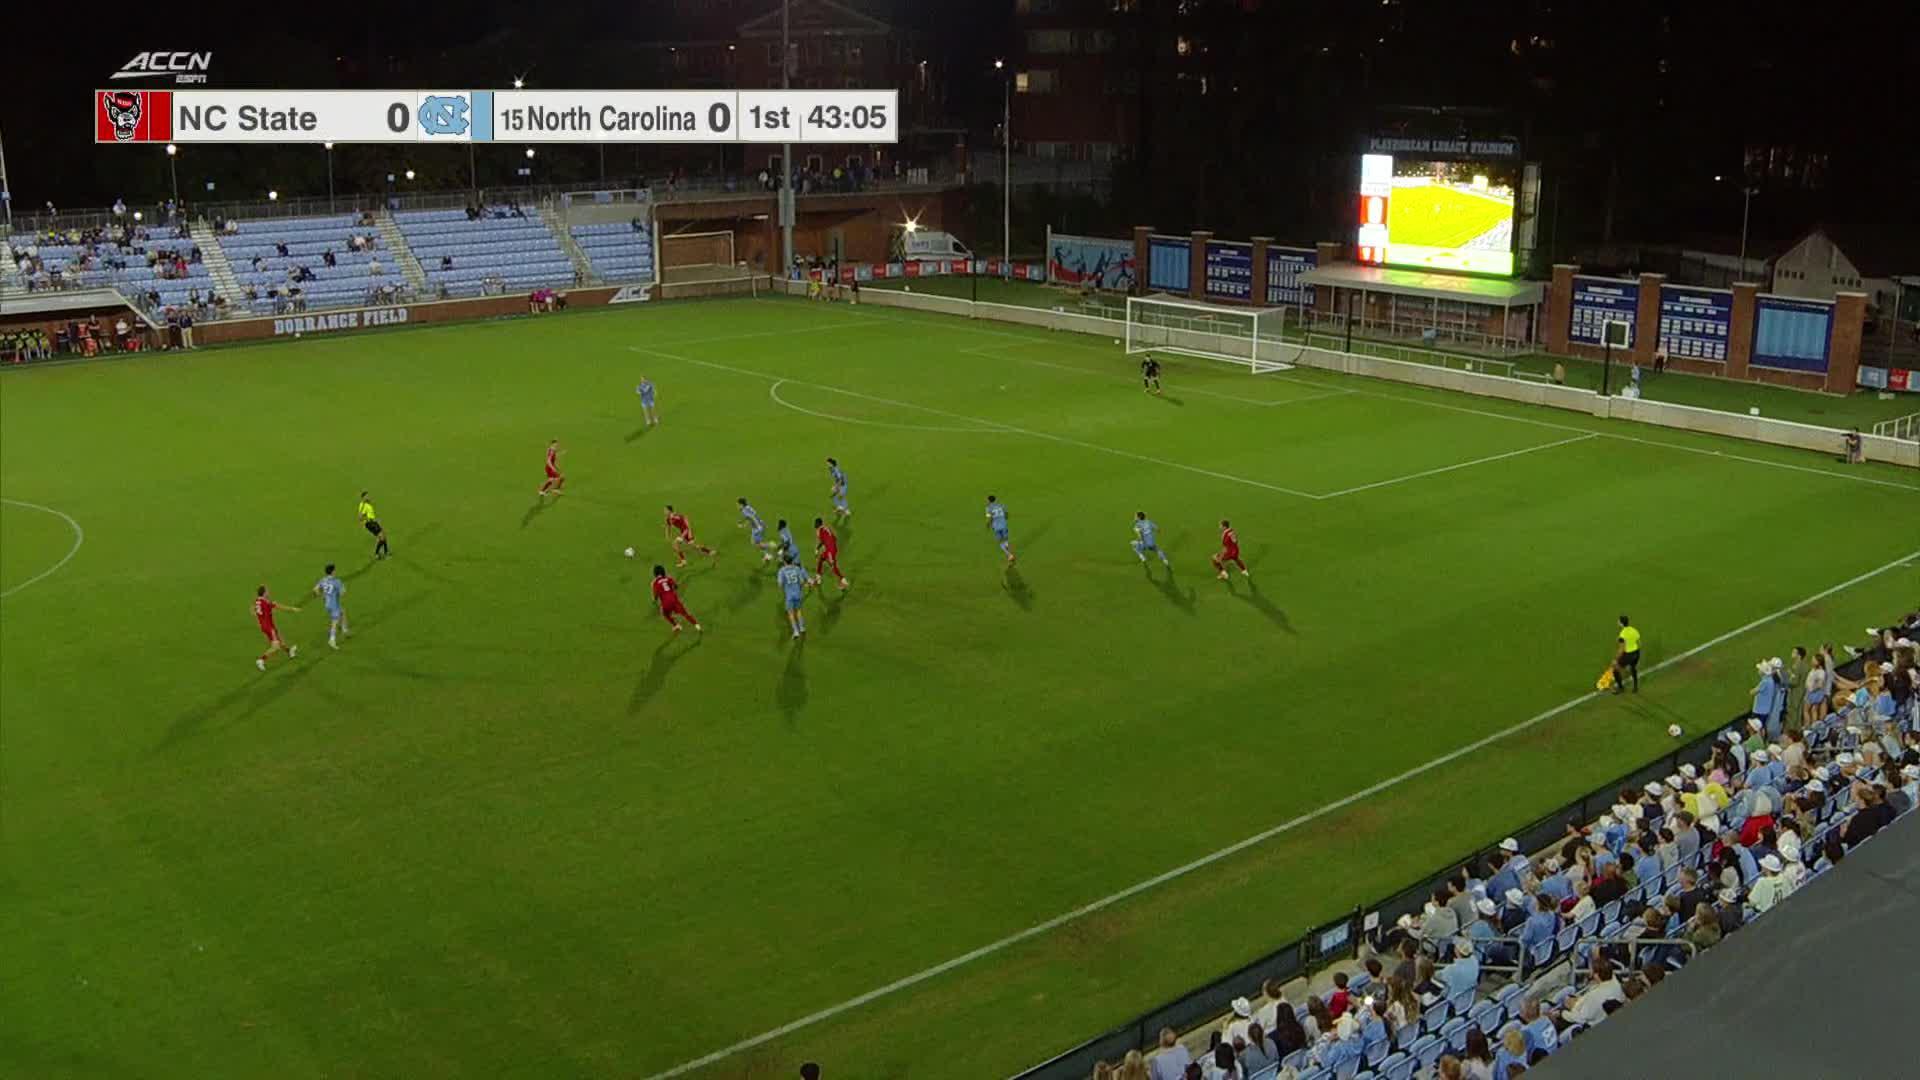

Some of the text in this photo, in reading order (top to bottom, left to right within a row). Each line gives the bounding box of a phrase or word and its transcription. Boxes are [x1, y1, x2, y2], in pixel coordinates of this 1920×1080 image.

[1470, 140, 1514, 155] STADIUM
[274, 308, 408, 335] DORRANCE FIELD
